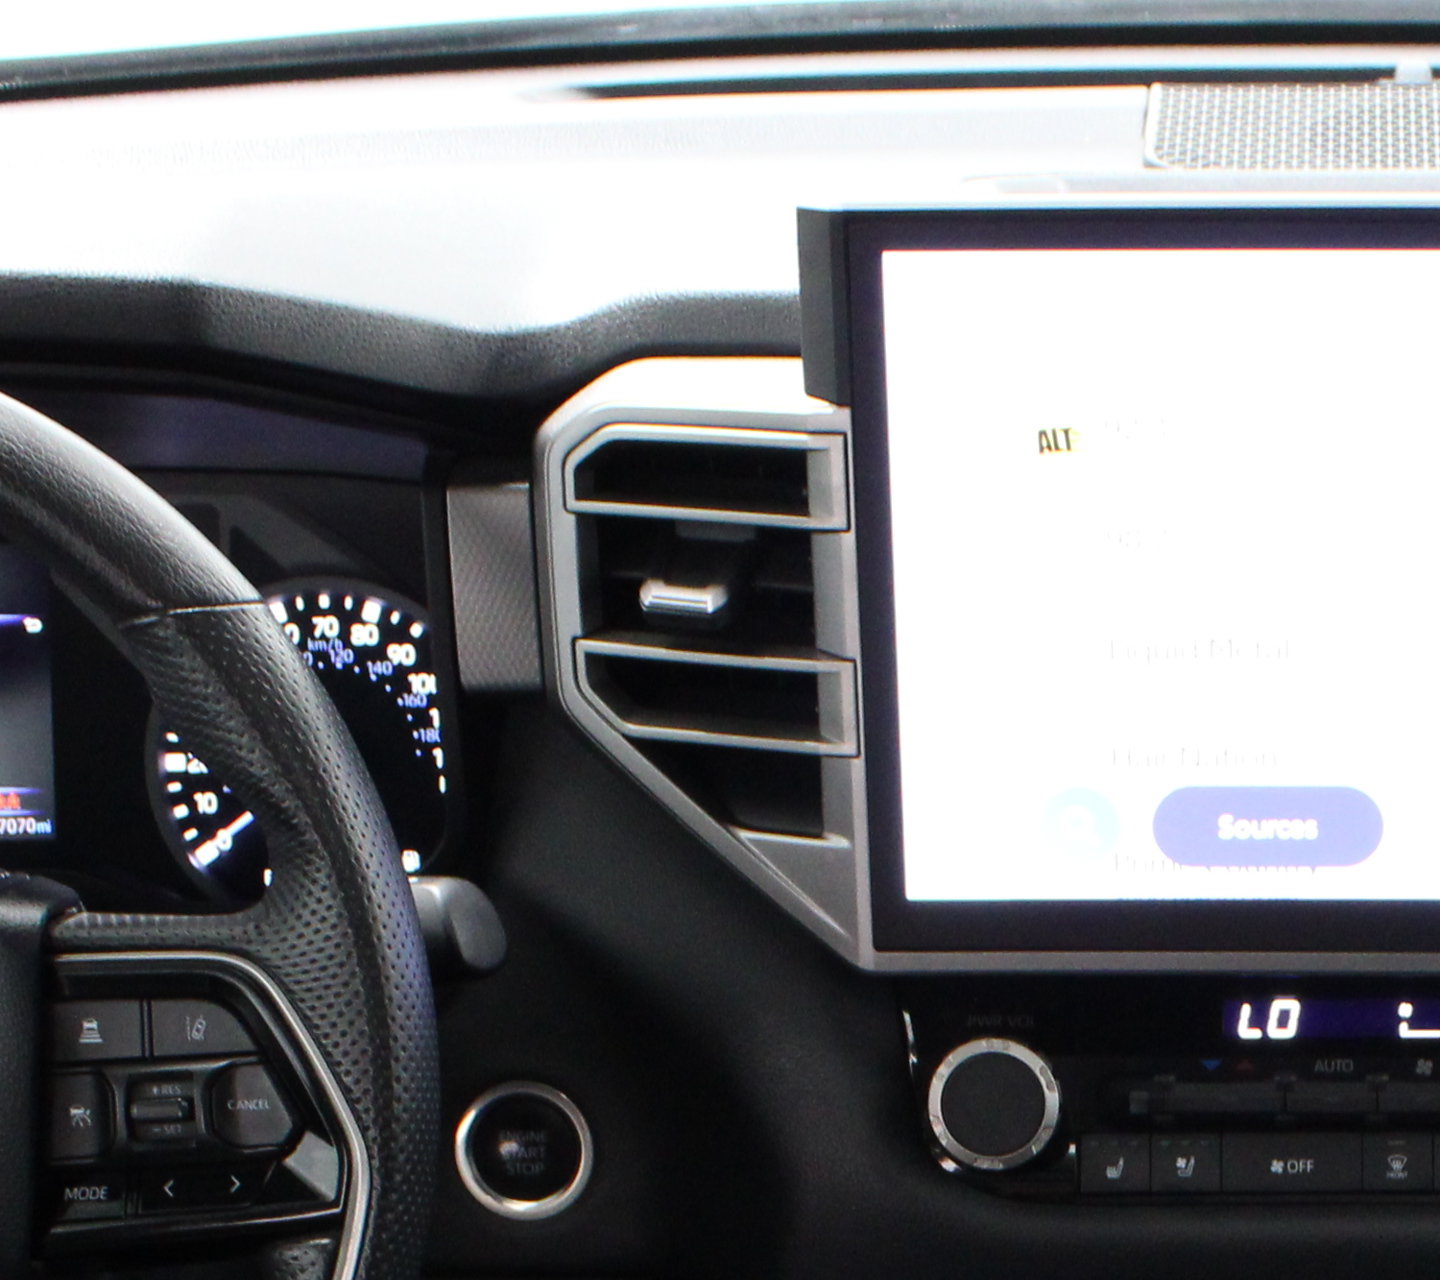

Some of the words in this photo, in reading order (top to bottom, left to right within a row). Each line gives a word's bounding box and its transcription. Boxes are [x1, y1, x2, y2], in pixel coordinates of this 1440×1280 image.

[1038, 427, 1072, 454] ALT
[312, 615, 339, 638] 70
[350, 623, 380, 647] 80
[307, 639, 343, 654] km/h
[386, 643, 416, 667] 90
[329, 648, 354, 665] 120
[367, 660, 393, 677] 140
[193, 792, 218, 815] 10
[1217, 812, 1319, 840] Sources
[1237, 997, 1301, 1040] LO
[1314, 1059, 1355, 1074] AUTO
[227, 1099, 271, 1111] CANCEL
[499, 1129, 549, 1142] ENGINE
[505, 1161, 545, 1175] STOP
[1287, 1159, 1315, 1174] OFF
[64, 1185, 109, 1201] MODE
